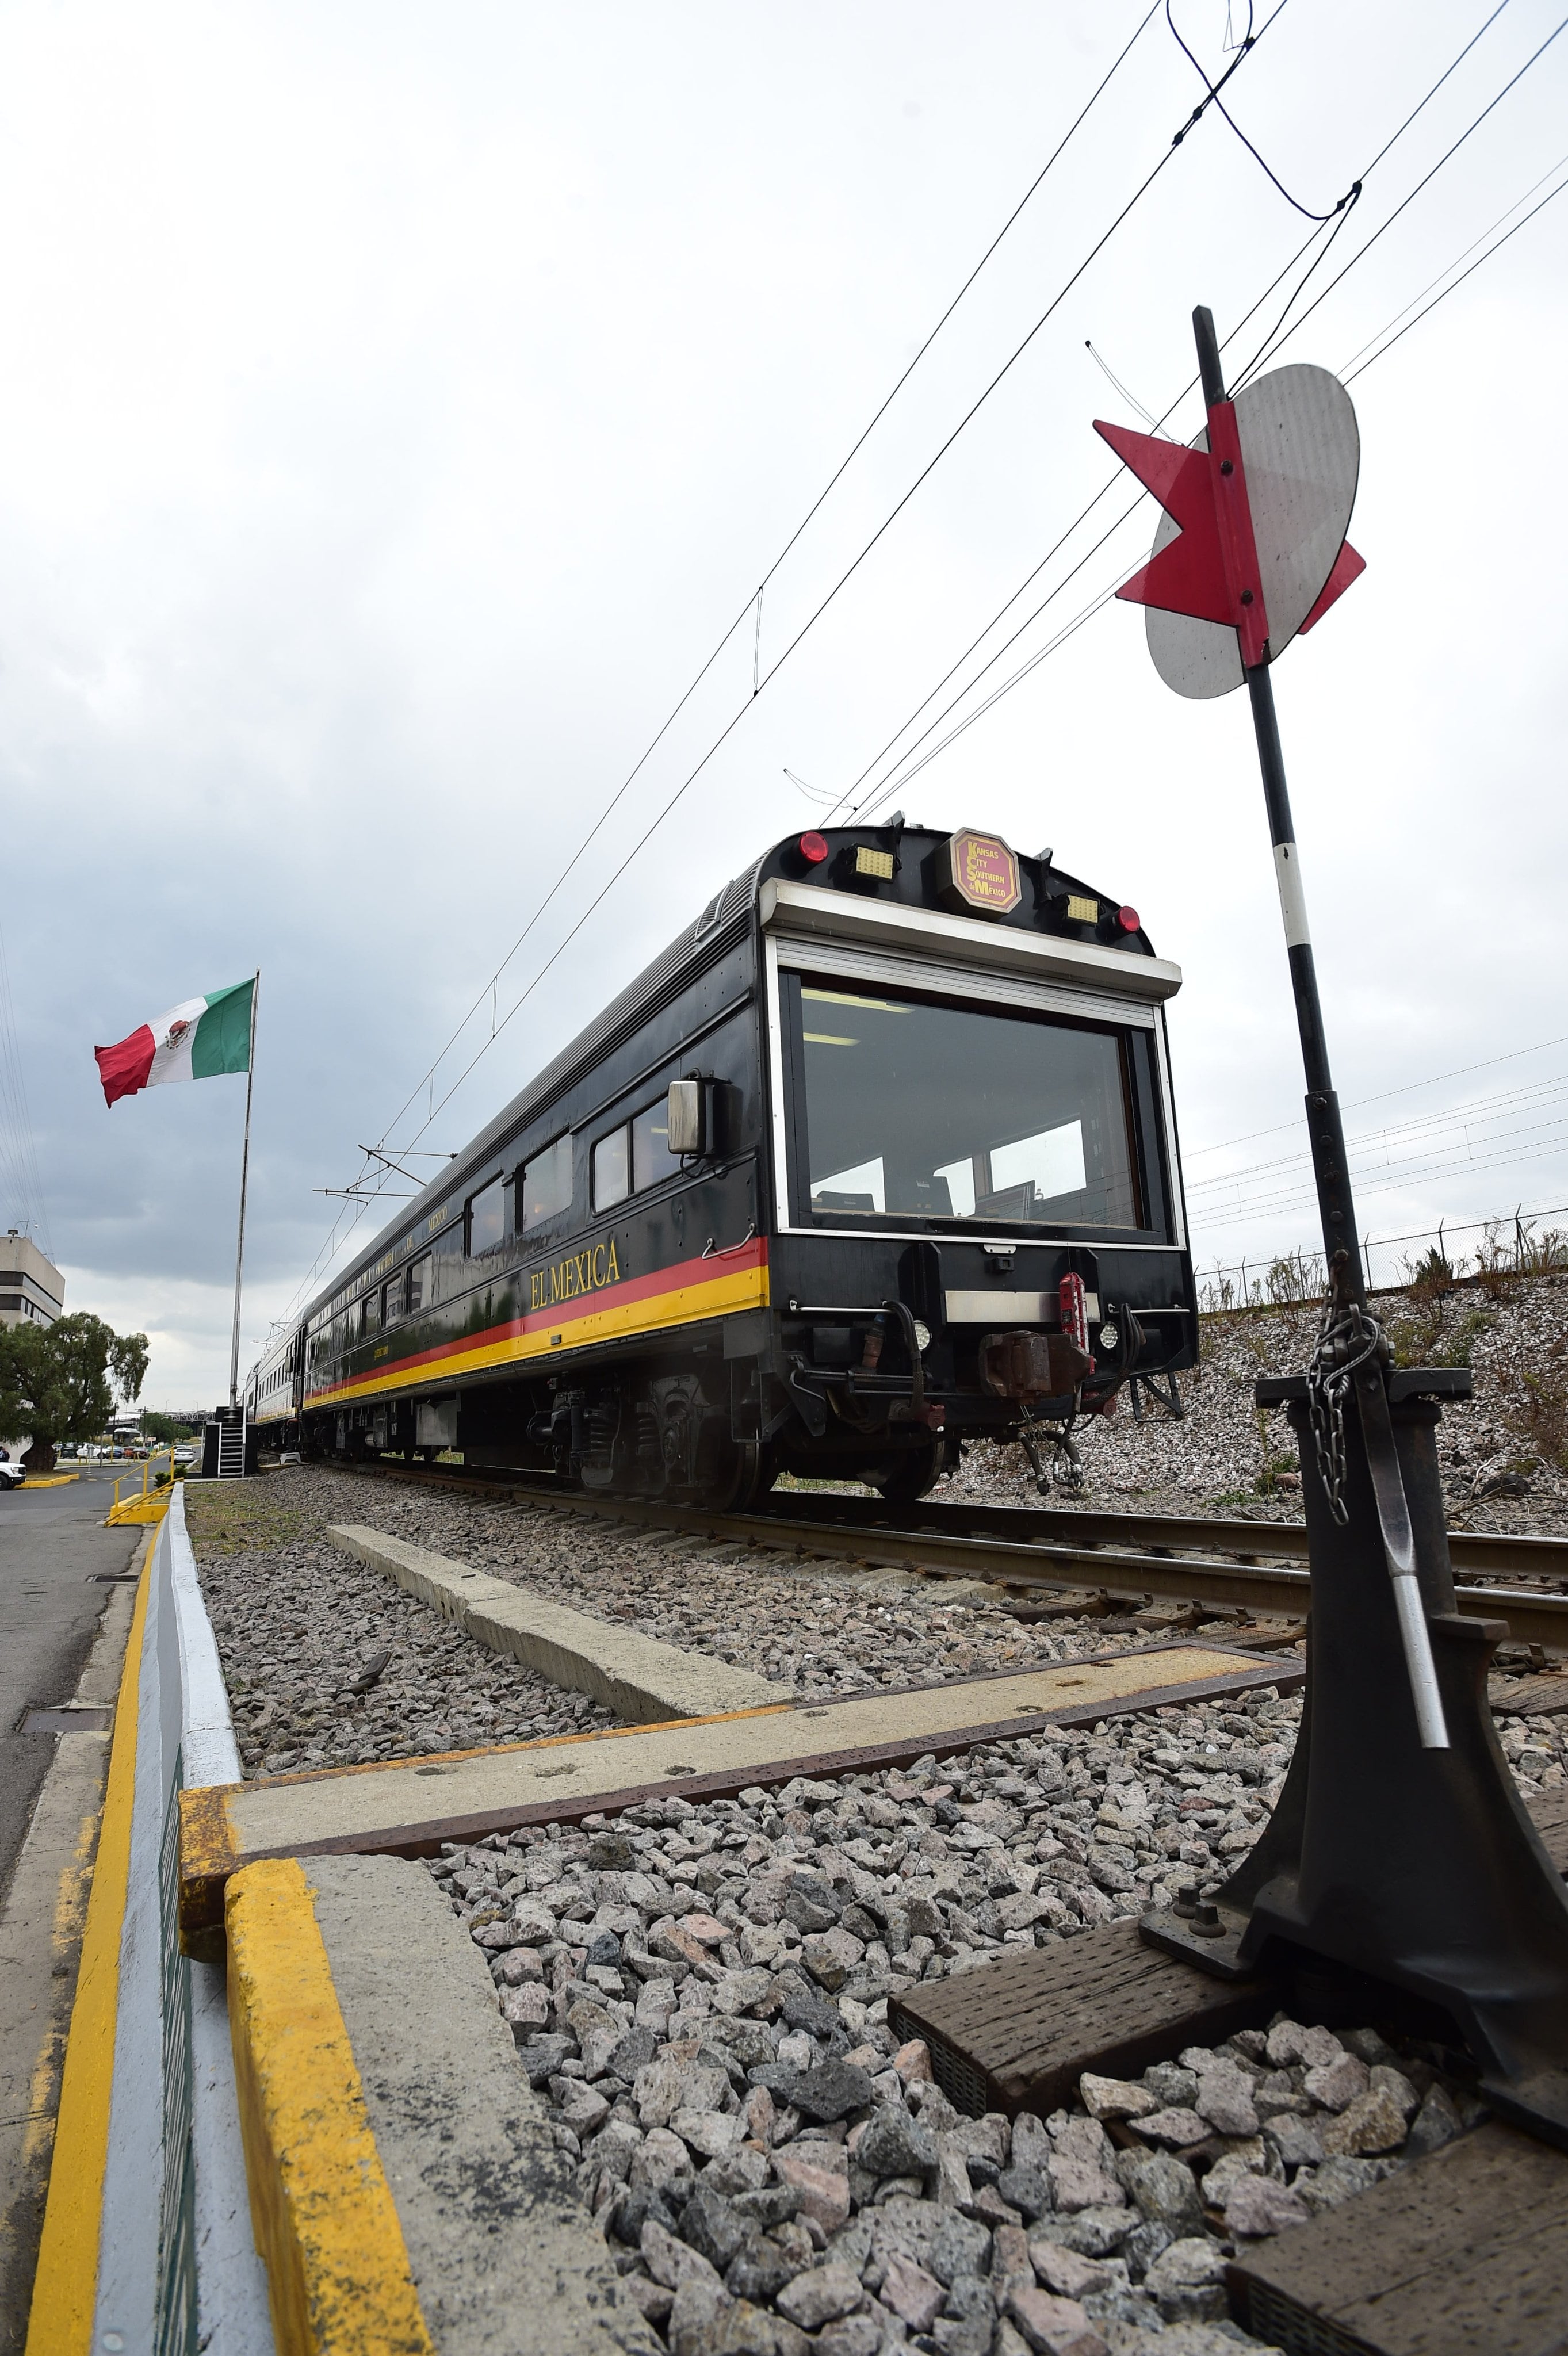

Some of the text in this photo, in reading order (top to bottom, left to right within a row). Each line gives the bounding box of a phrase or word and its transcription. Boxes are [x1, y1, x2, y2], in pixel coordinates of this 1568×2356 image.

[967, 840, 999, 859] KANSAS
[966, 856, 988, 870] CITY
[966, 866, 1005, 884] SOUTHERN
[429, 1206, 447, 1232] MEXICO
[531, 1239, 621, 1310] EL MEXICA
